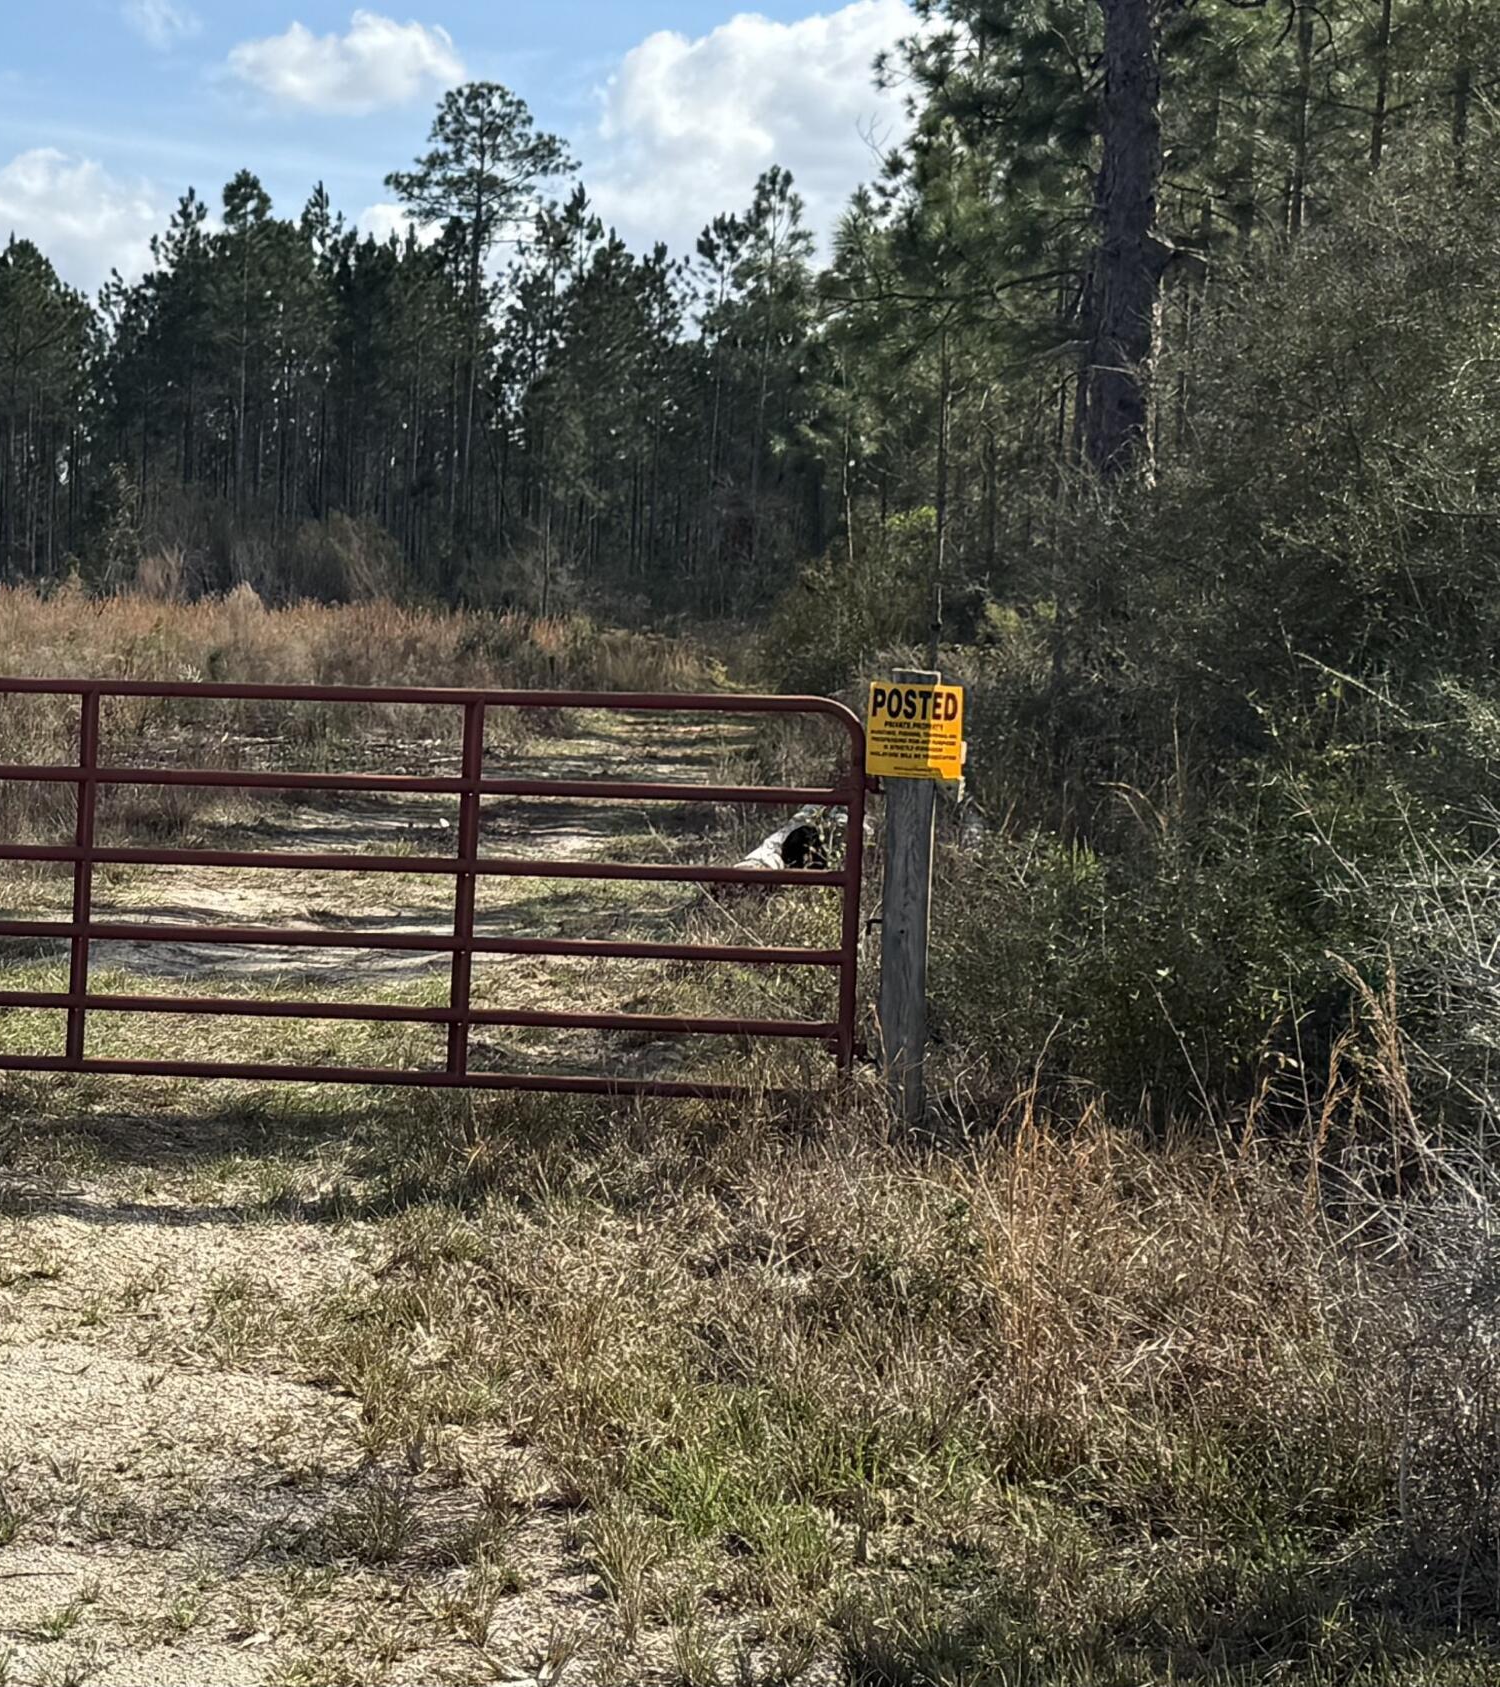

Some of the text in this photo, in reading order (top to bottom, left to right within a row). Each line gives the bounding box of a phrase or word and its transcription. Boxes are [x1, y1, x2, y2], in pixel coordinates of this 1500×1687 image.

[871, 688, 959, 721] POSTED
[884, 721, 943, 731] PRIVATE PROPRTY
